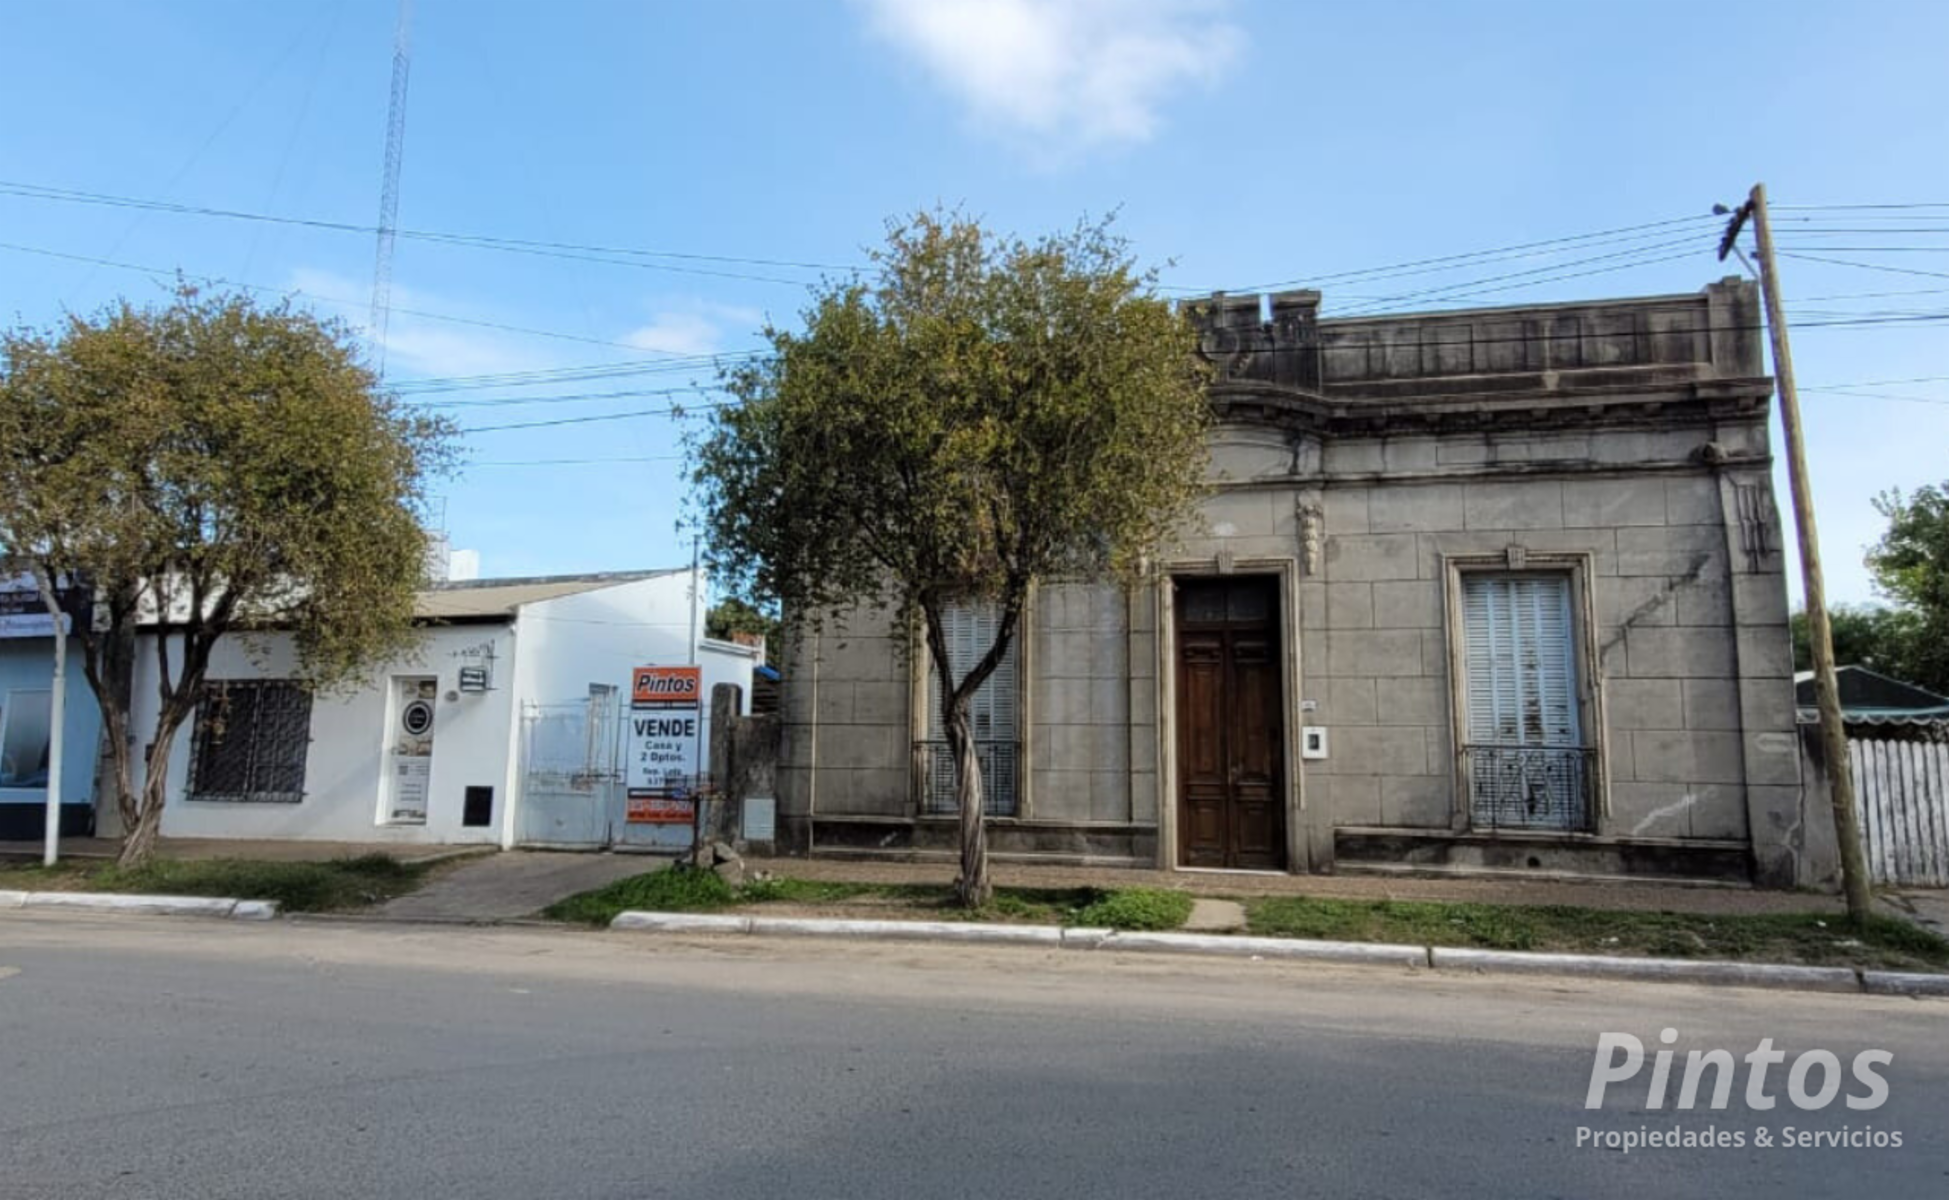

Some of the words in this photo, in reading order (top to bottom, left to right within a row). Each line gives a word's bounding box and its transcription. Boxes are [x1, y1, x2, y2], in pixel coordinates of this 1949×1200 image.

[637, 673, 695, 692] Pintos
[634, 719, 695, 737] VENDE
[645, 741, 673, 750] Casa
[675, 742, 682, 752] y
[640, 752, 647, 761] 2
[650, 752, 686, 763] Dptos.
